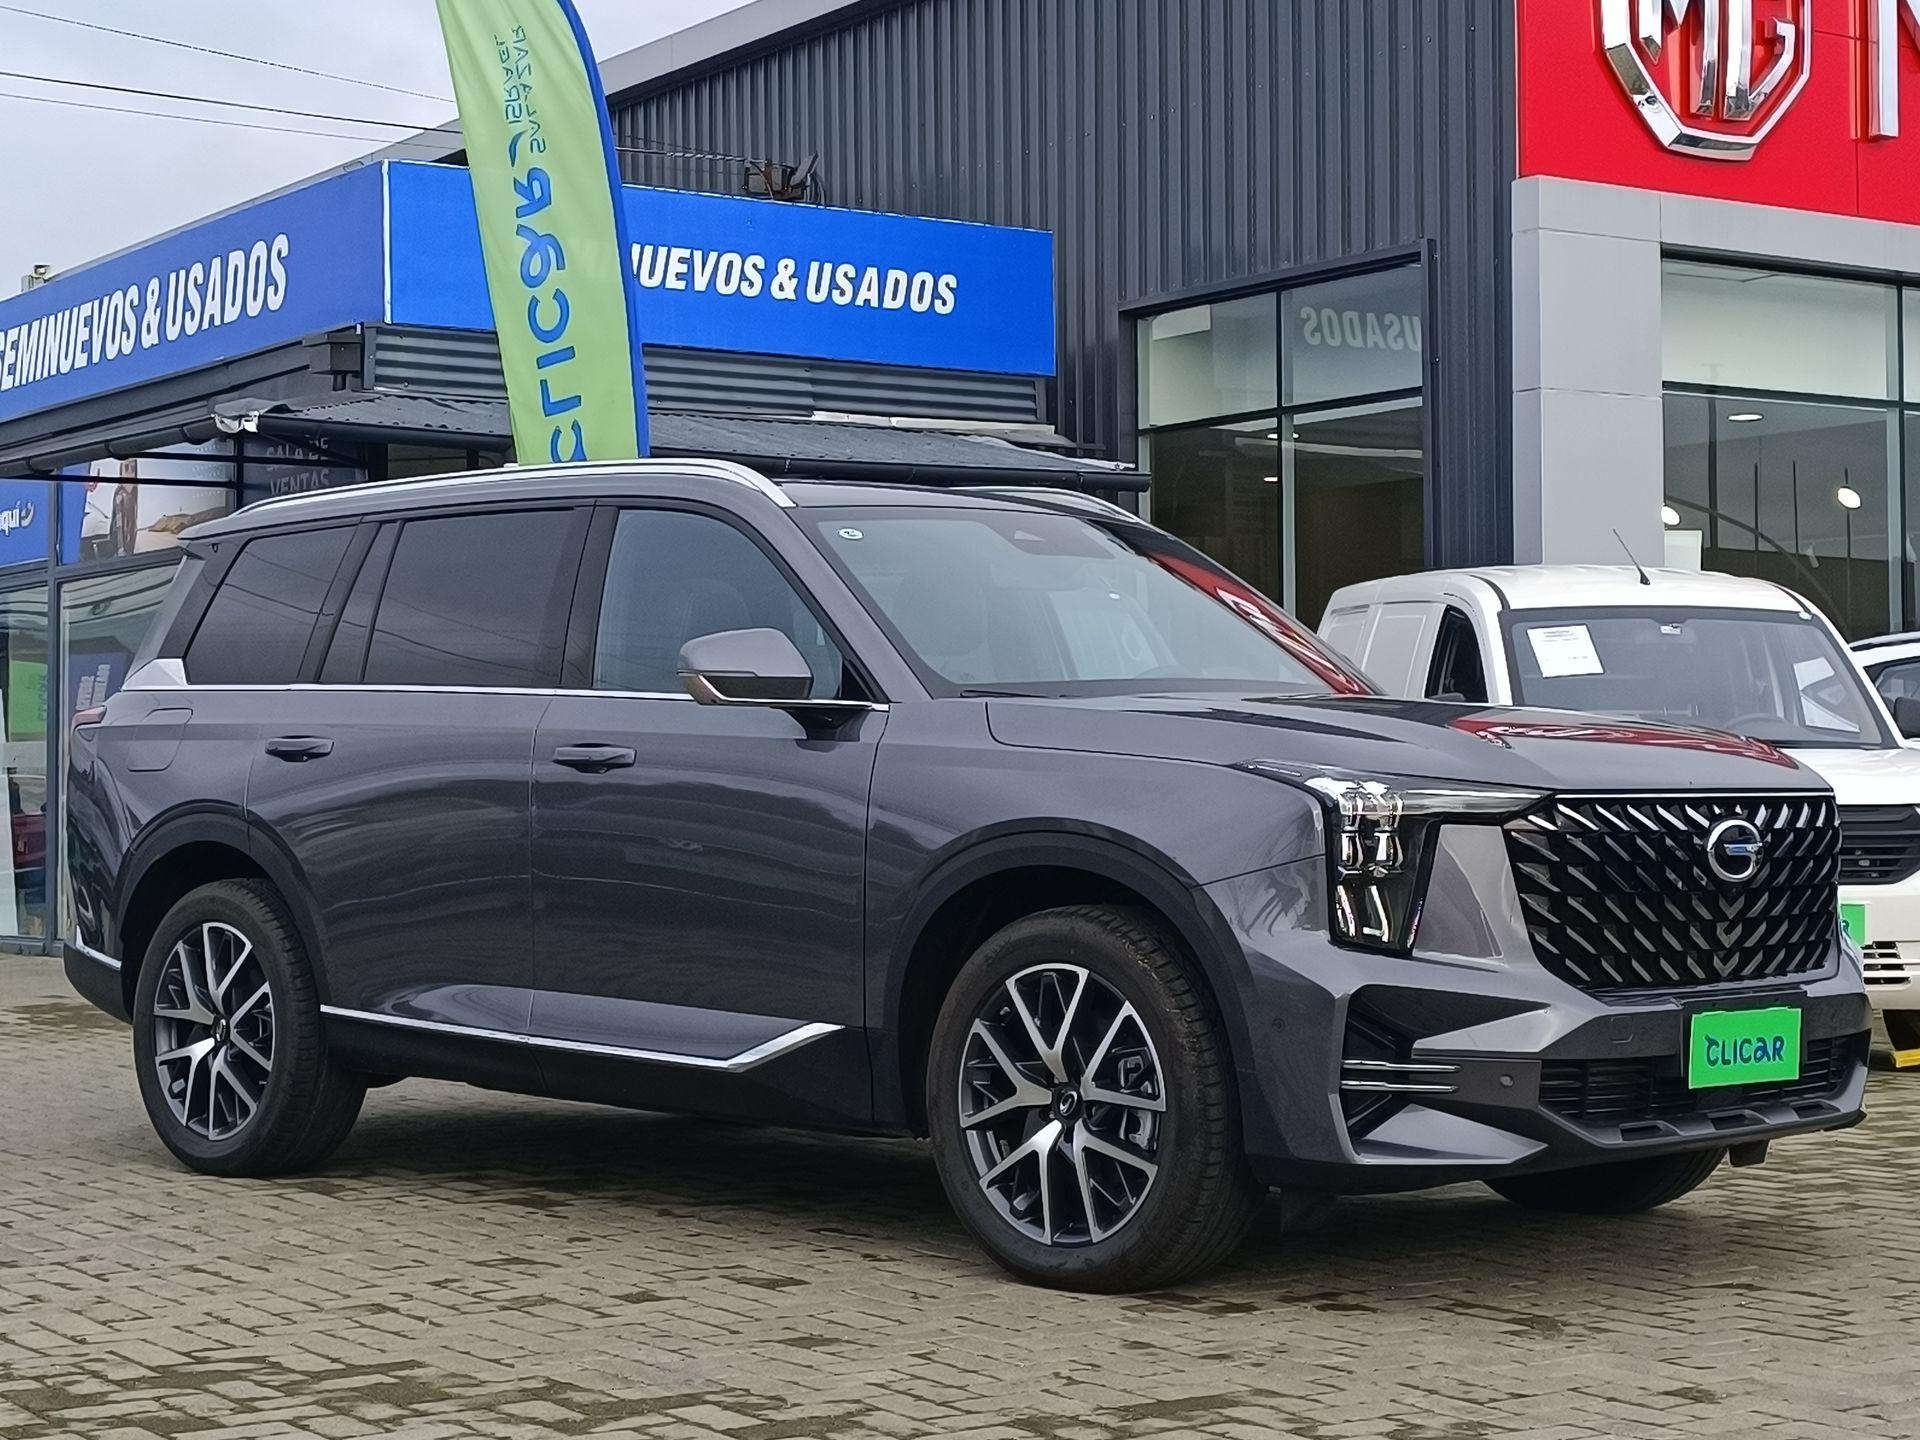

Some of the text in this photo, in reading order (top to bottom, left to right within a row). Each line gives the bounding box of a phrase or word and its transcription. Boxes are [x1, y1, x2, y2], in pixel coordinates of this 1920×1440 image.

[770, 258, 798, 300] &
[806, 261, 957, 315] USADOS
[0, 233, 289, 391] EMINUEVOS & USADOS
[270, 468, 329, 495] VENTAS
[0, 500, 20, 536] quí
